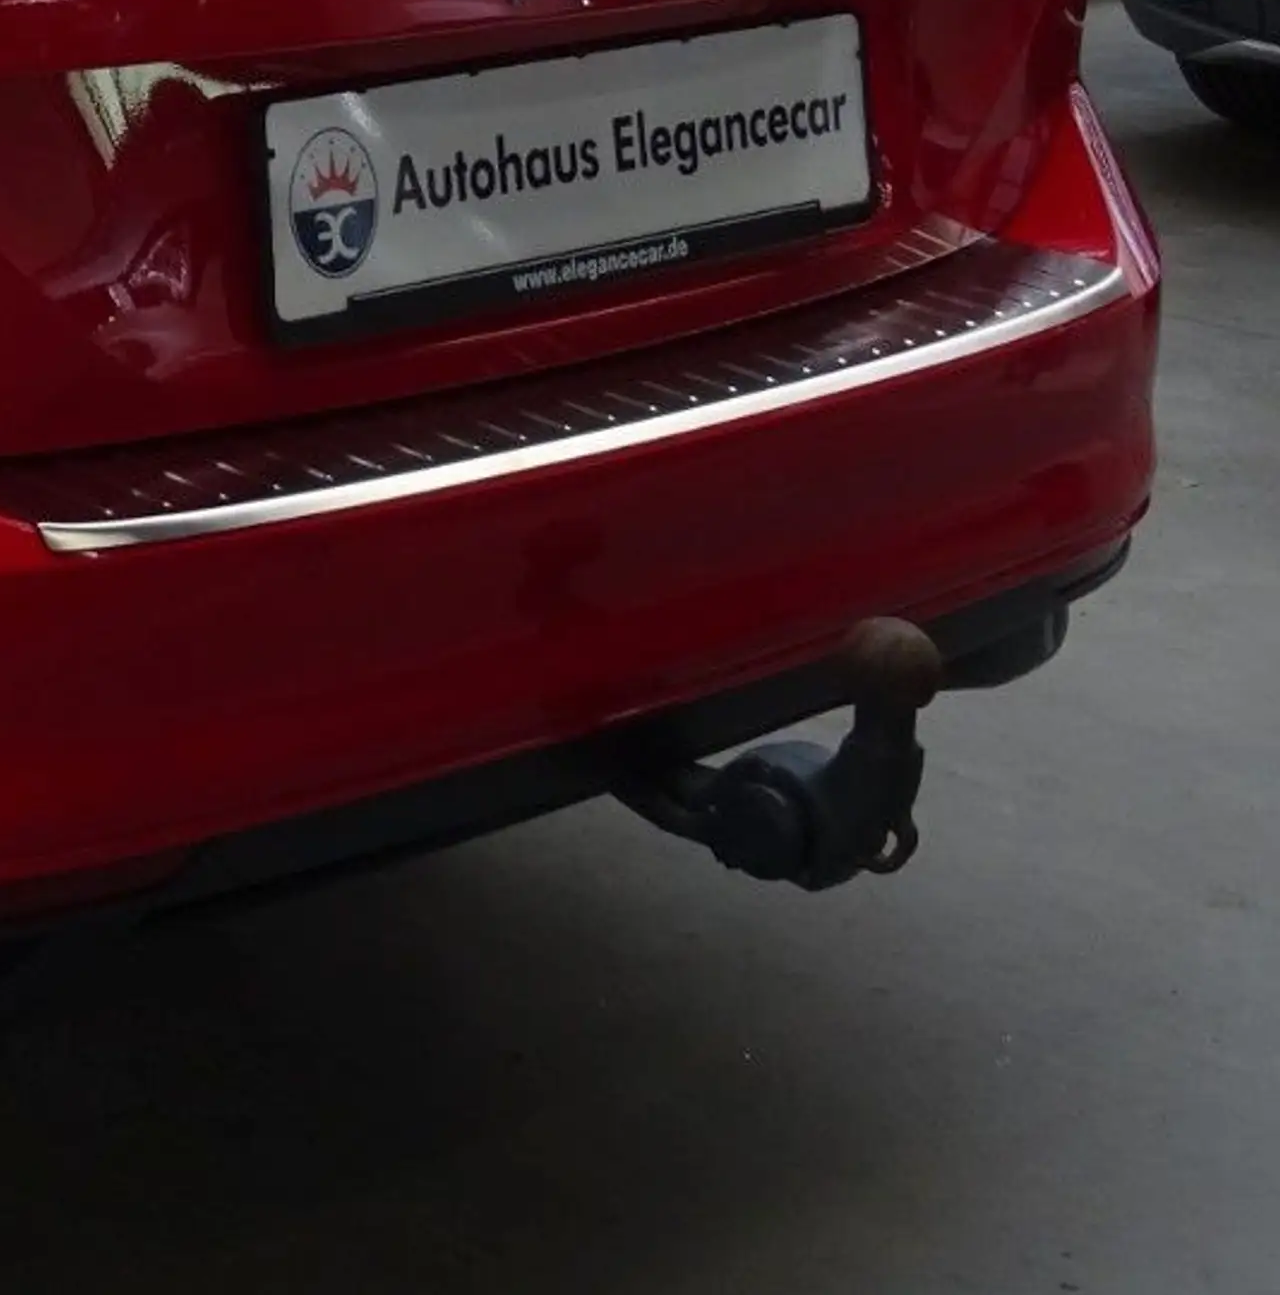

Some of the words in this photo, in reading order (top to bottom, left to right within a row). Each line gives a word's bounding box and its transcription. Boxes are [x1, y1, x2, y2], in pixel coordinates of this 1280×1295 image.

[392, 134, 600, 215] Autohaus
[613, 94, 847, 178] Elegancecar
[512, 234, 690, 293] www.elegancecar.de
